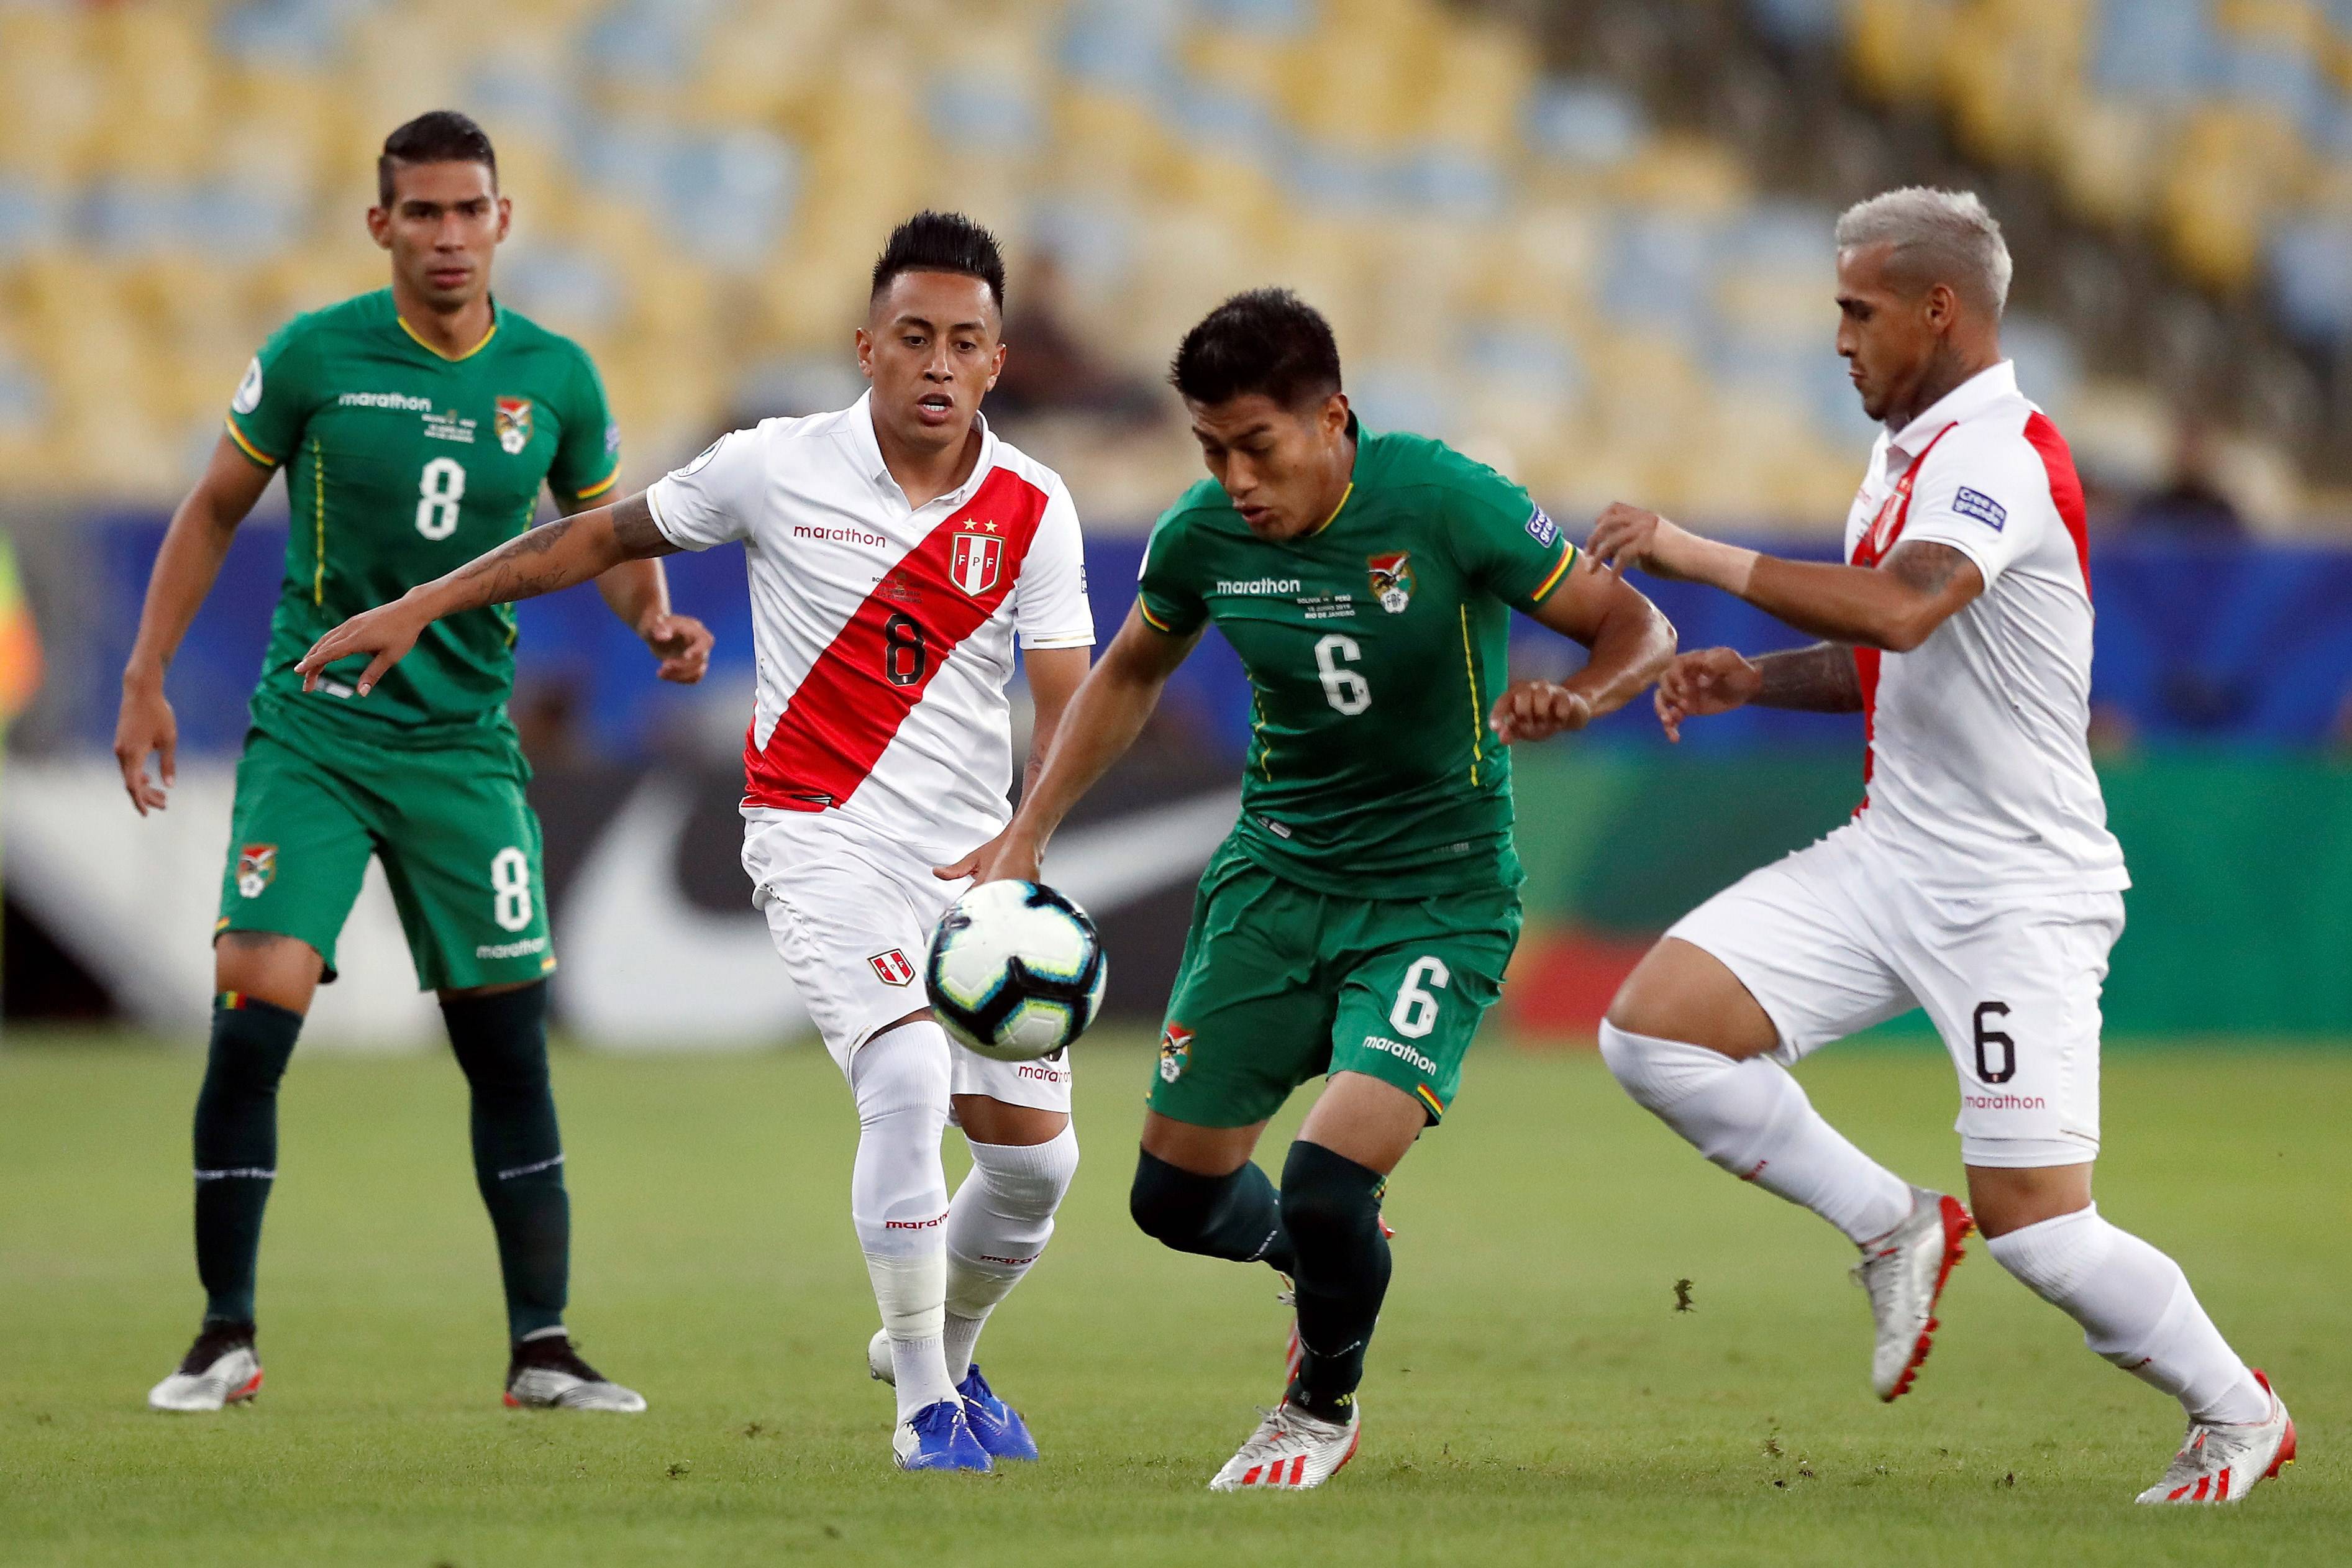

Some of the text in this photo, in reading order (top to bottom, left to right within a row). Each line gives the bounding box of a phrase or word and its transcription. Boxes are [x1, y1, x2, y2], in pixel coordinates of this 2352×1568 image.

[339, 392, 432, 412] marathon
[415, 456, 466, 540] 8
[793, 526, 886, 548] marathon
[1216, 577, 1300, 595] marathon
[885, 614, 926, 687] 8
[1315, 634, 1372, 716] 6
[491, 846, 533, 932] 8
[1389, 955, 1449, 1039] 6
[1362, 1035, 1437, 1076] marathon
[1973, 1001, 2015, 1083] 6
[1018, 1065, 1071, 1083] maraho
[1966, 1095, 2045, 1109] marathon
[886, 1208, 949, 1229] marath
